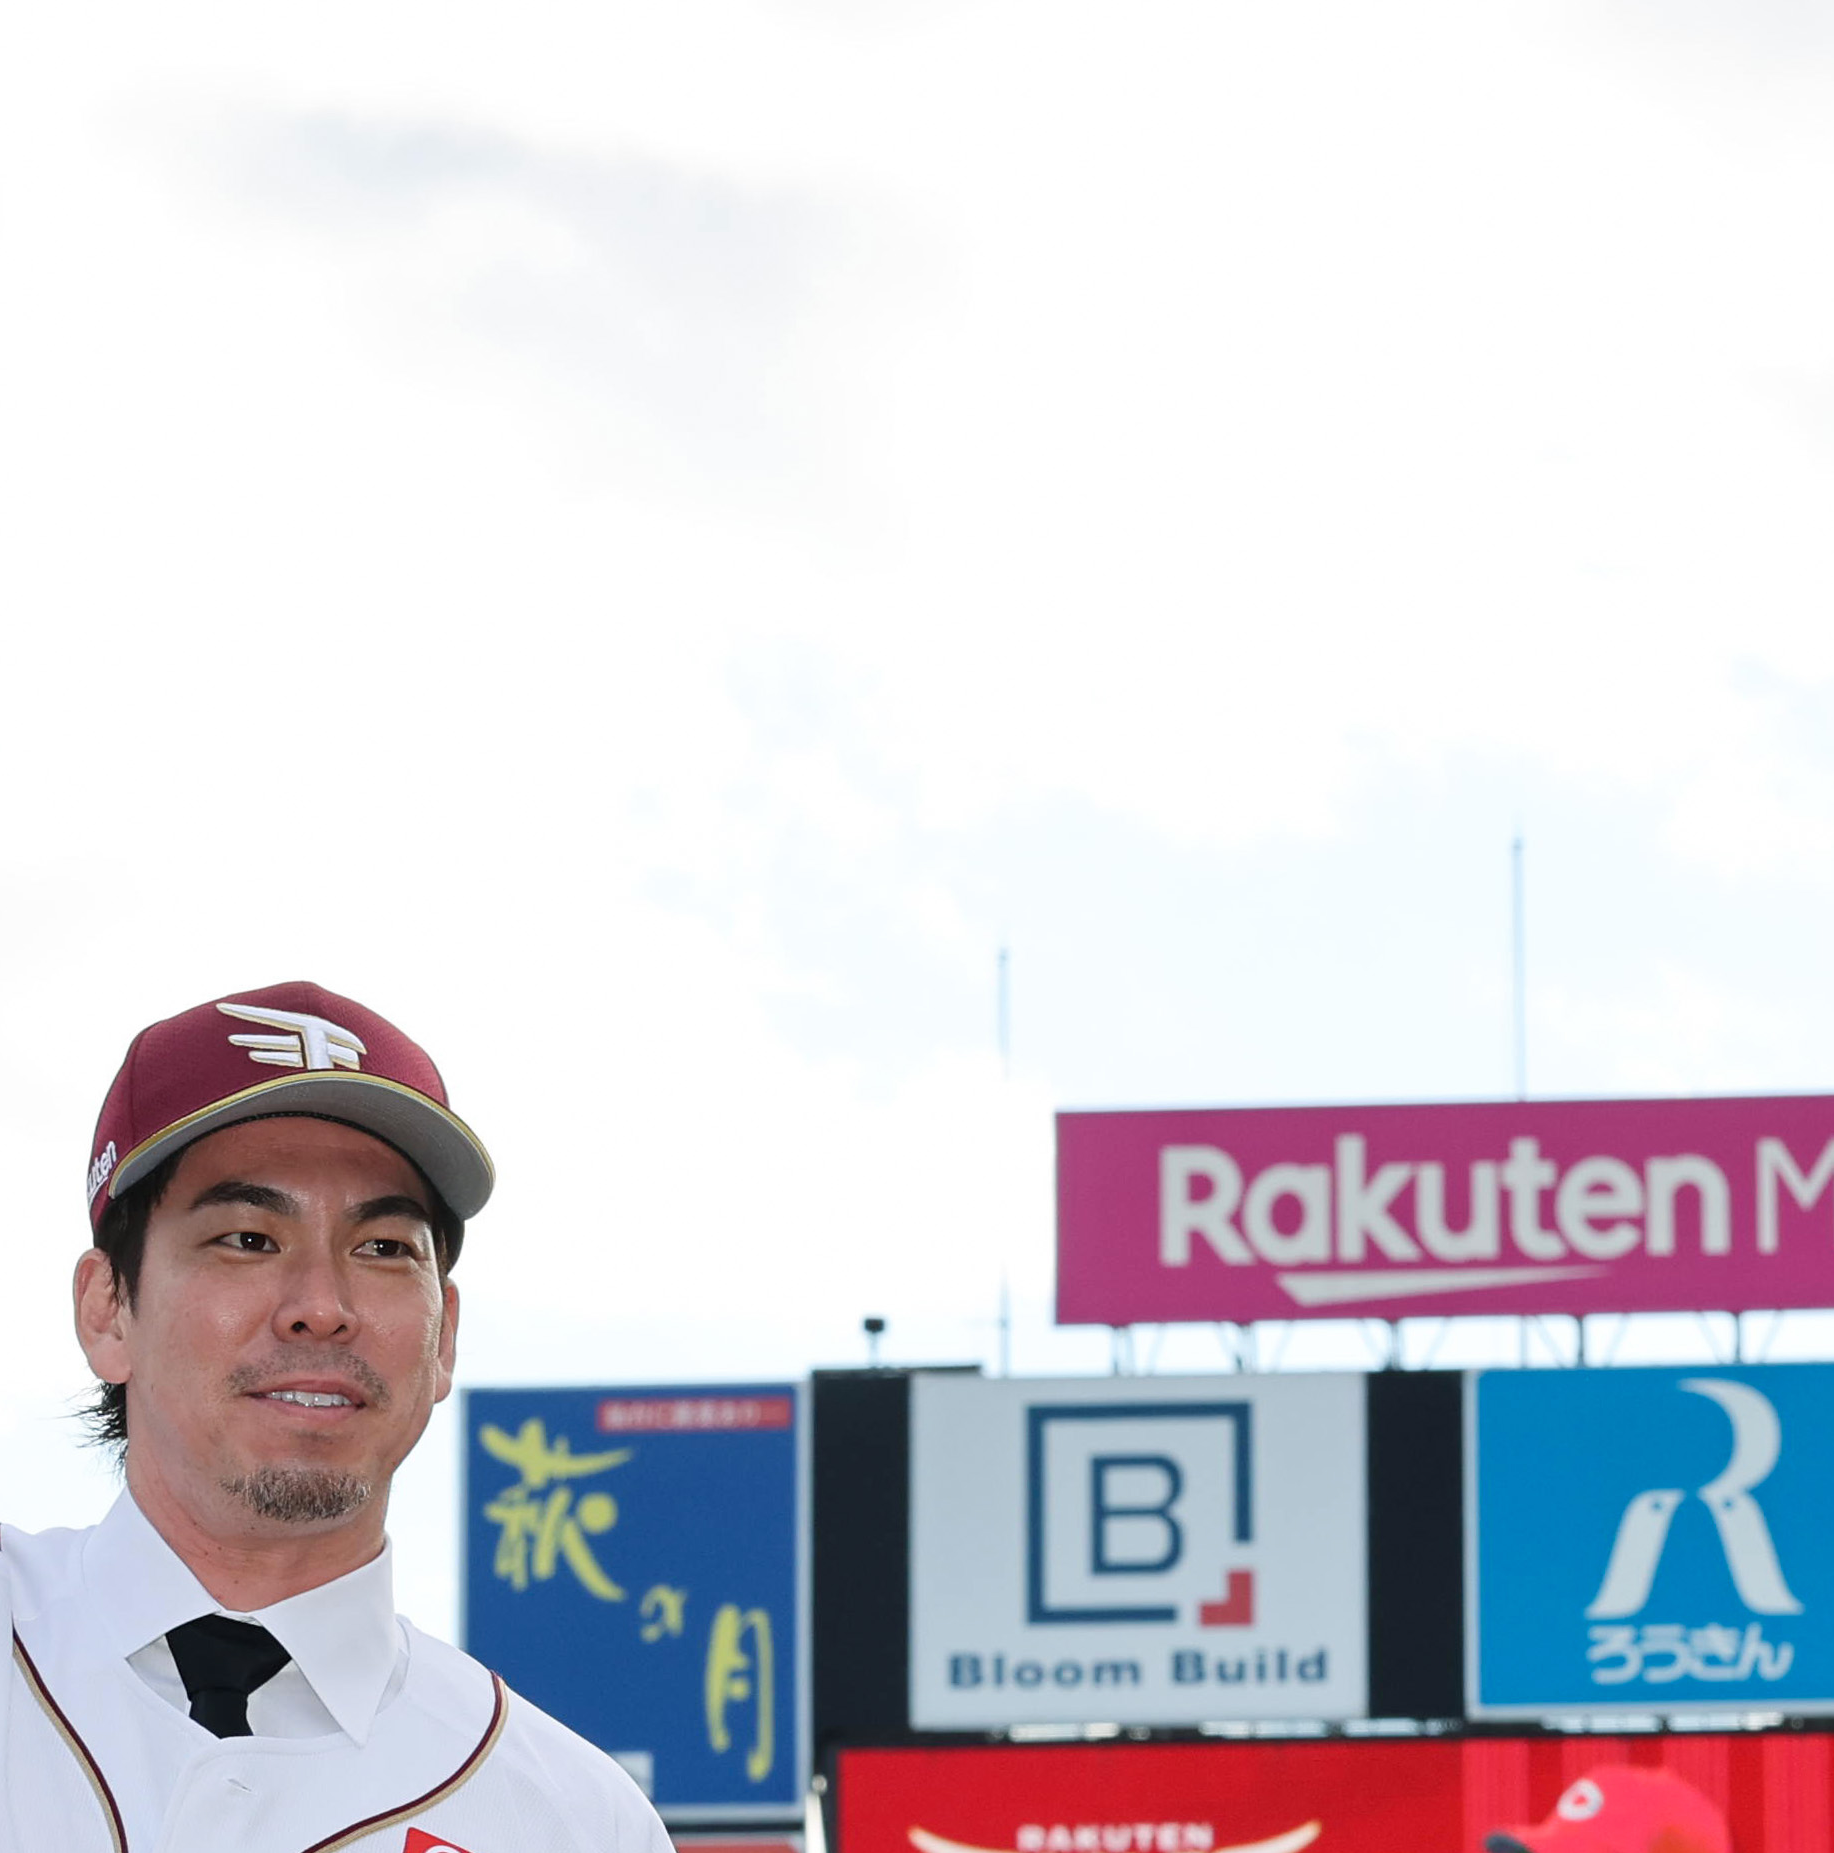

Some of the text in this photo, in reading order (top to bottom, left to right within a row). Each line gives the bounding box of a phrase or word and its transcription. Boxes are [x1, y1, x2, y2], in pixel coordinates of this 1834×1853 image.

[1160, 1133, 1732, 1268] Rakuten
[948, 1647, 1330, 1691] Bloom Build
[1587, 1622, 1794, 1685] ろうきん
[1016, 1823, 1215, 1853] RAKUTEN
